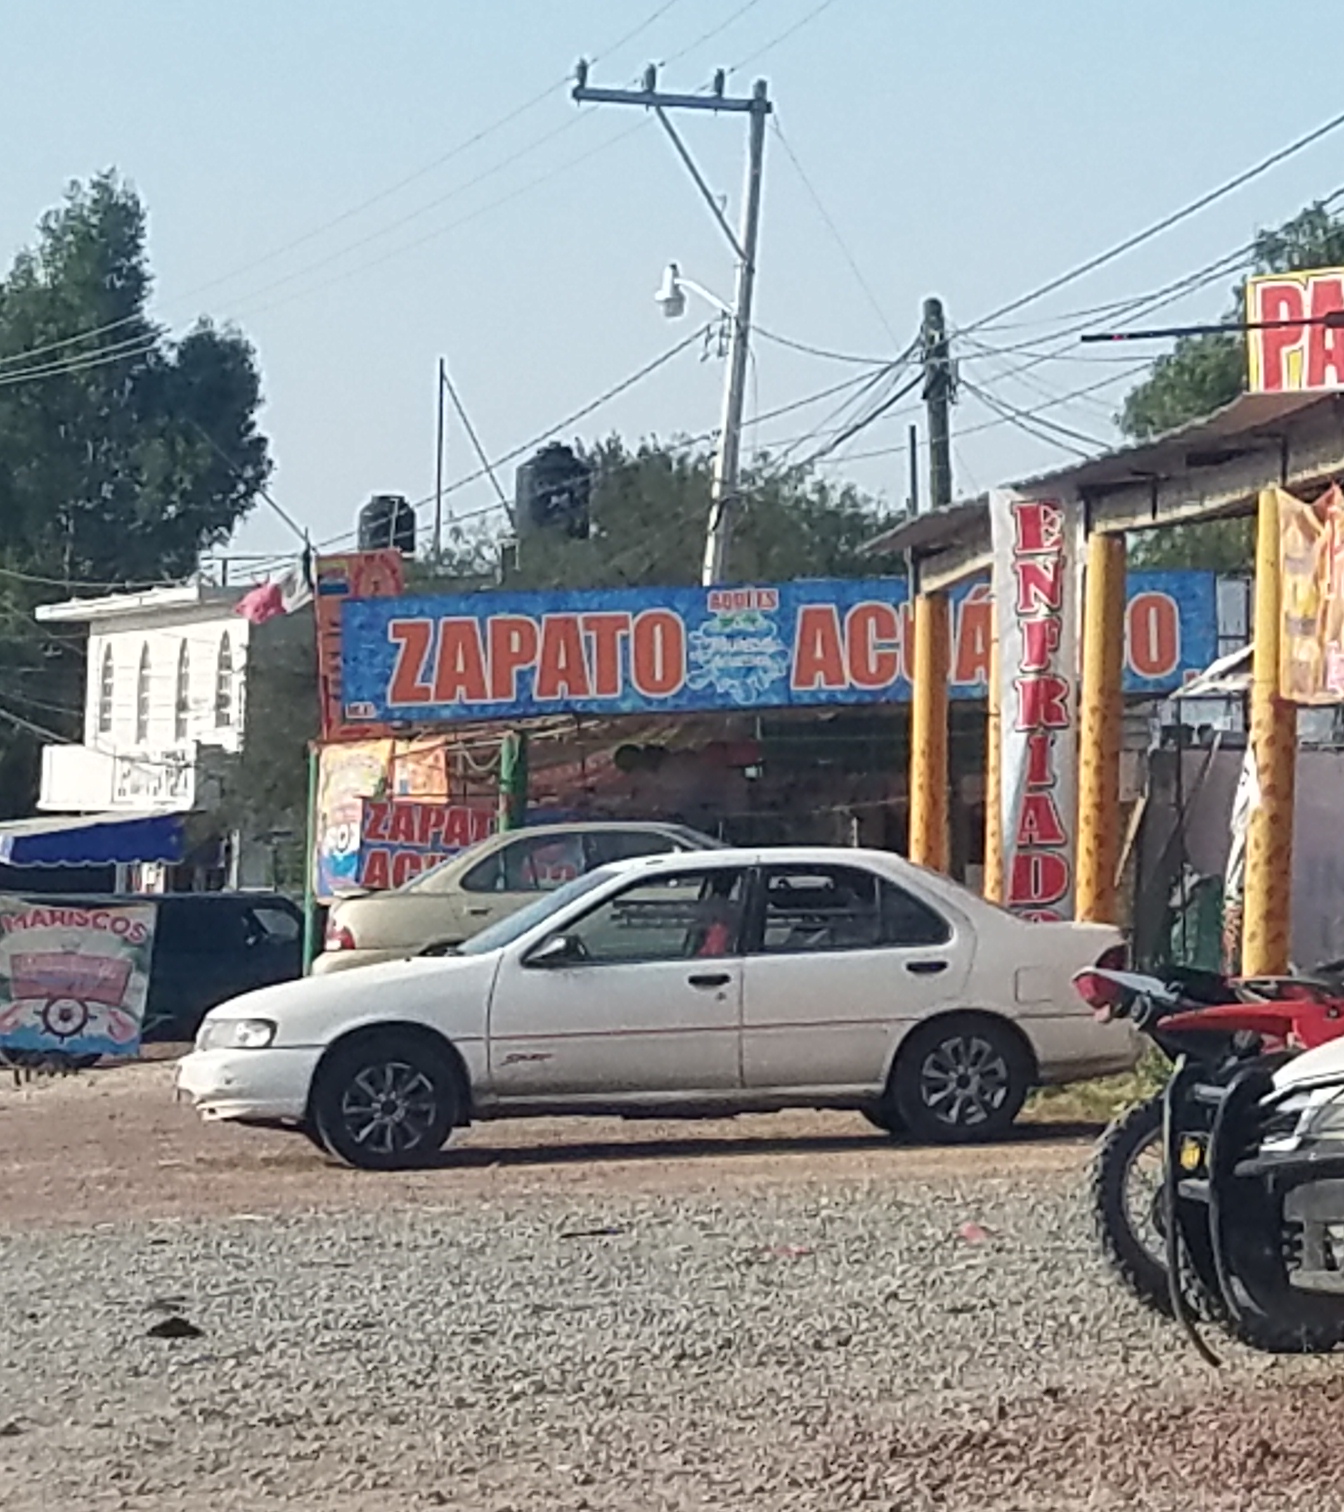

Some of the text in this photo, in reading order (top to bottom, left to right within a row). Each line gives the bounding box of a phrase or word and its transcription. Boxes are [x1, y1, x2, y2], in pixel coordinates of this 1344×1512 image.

[388, 608, 686, 707] ZAPATO
[790, 582, 1180, 691] ACÁO
[1009, 499, 1069, 922] ENFRIAD
[363, 800, 499, 848] ZAPAT
[2, 908, 149, 944] MARISCOS
